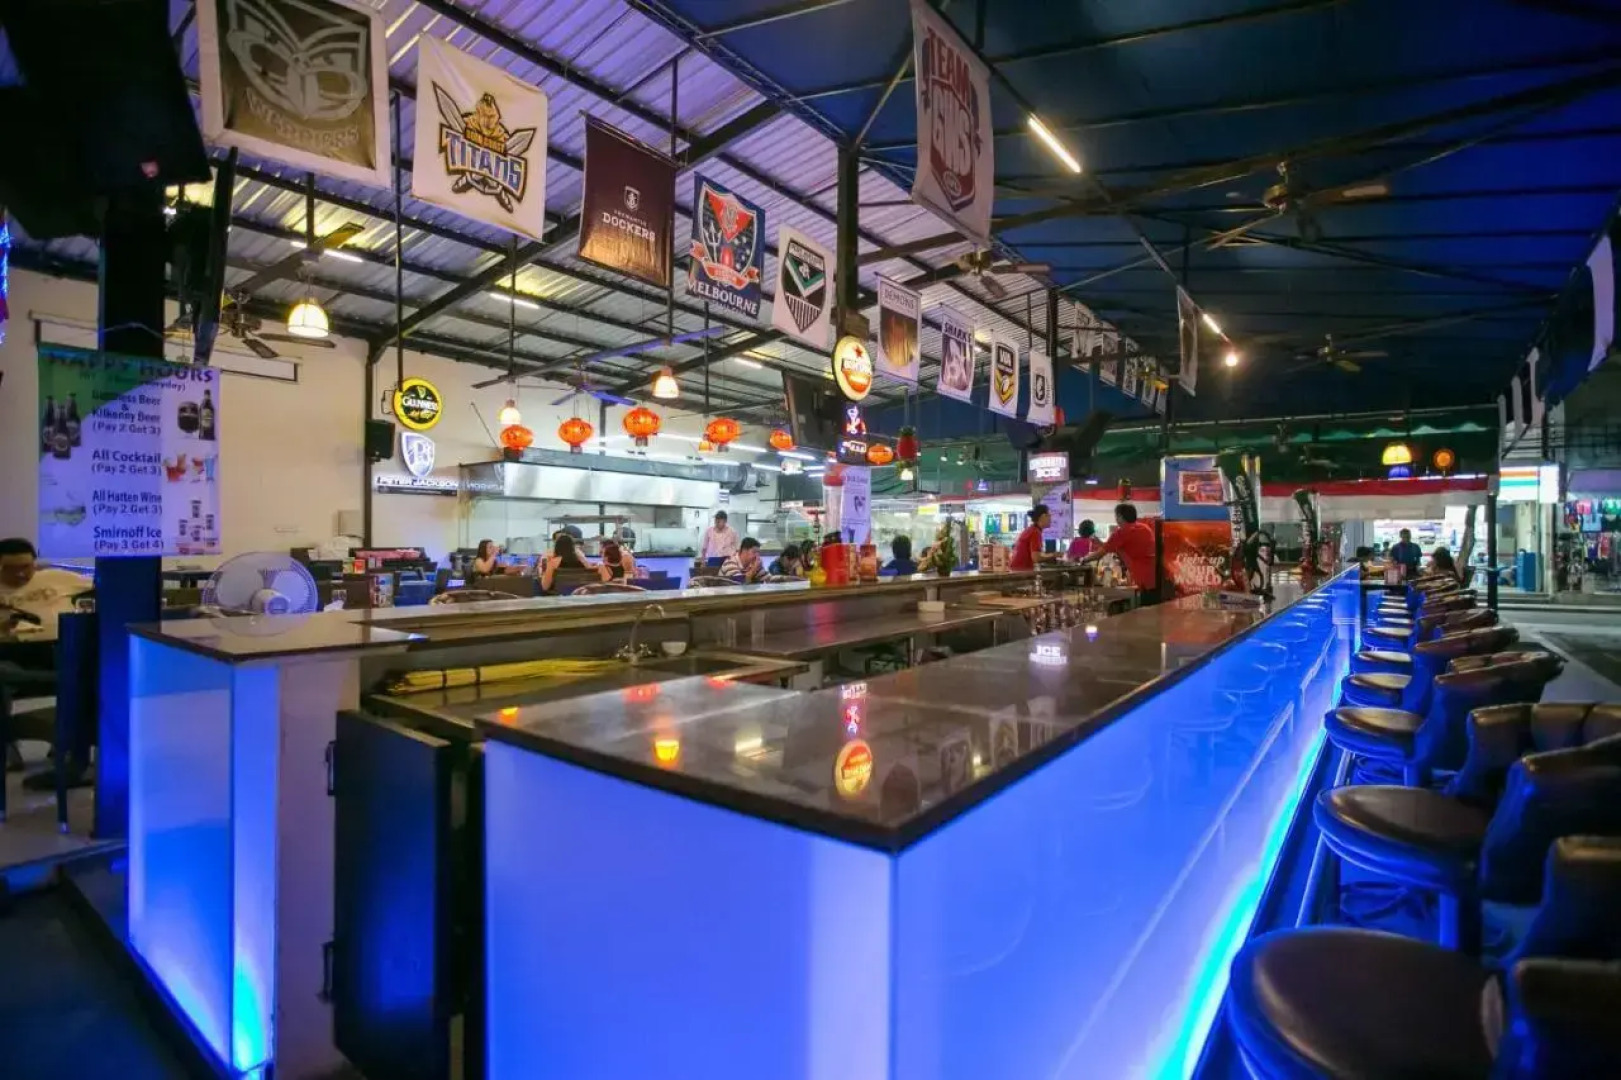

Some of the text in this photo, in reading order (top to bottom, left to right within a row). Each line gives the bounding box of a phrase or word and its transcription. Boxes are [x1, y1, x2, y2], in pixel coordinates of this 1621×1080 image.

[446, 131, 523, 192] TITANS
[602, 211, 656, 241] DOCKERS
[687, 279, 758, 315] MELBOURNE
[92, 408, 161, 424] Kilkenny Beer
[92, 422, 116, 434] (Pay
[128, 424, 147, 434] Get
[92, 450, 161, 464] All Cocktail
[91, 463, 116, 474] (Pay
[118, 464, 127, 474] 2
[129, 464, 148, 474] Get
[92, 490, 105, 501] All
[140, 491, 162, 503] Wine
[92, 504, 117, 516] (Pay
[119, 505, 128, 515] 2
[130, 505, 149, 515] Get
[93, 526, 162, 539] Smirnoff Ice
[93, 540, 119, 552] (Pay
[120, 540, 129, 550] 3
[131, 540, 150, 550] Get
